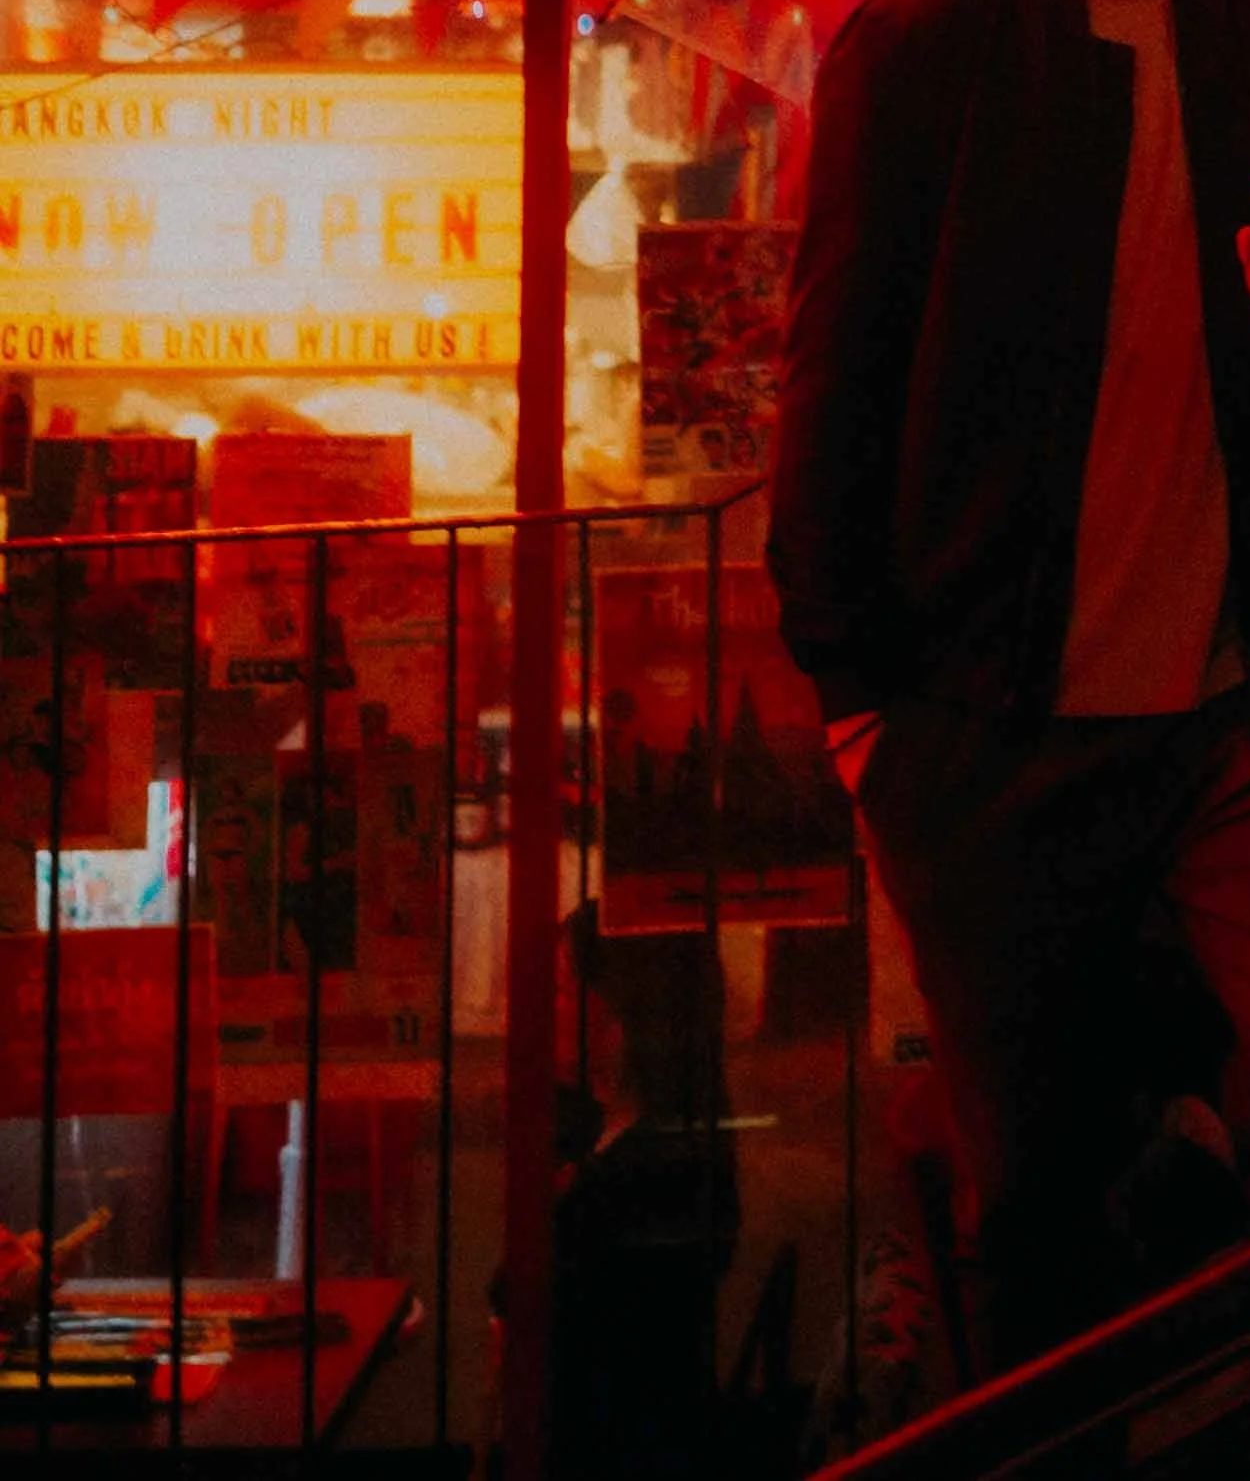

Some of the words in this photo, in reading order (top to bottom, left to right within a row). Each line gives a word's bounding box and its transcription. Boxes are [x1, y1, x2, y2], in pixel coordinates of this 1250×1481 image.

[0, 97, 167, 138] ANGKOK
[213, 97, 334, 137] NIGHT
[248, 191, 479, 265] OPEN
[1, 321, 98, 361] COME
[299, 321, 391, 361] WITH
